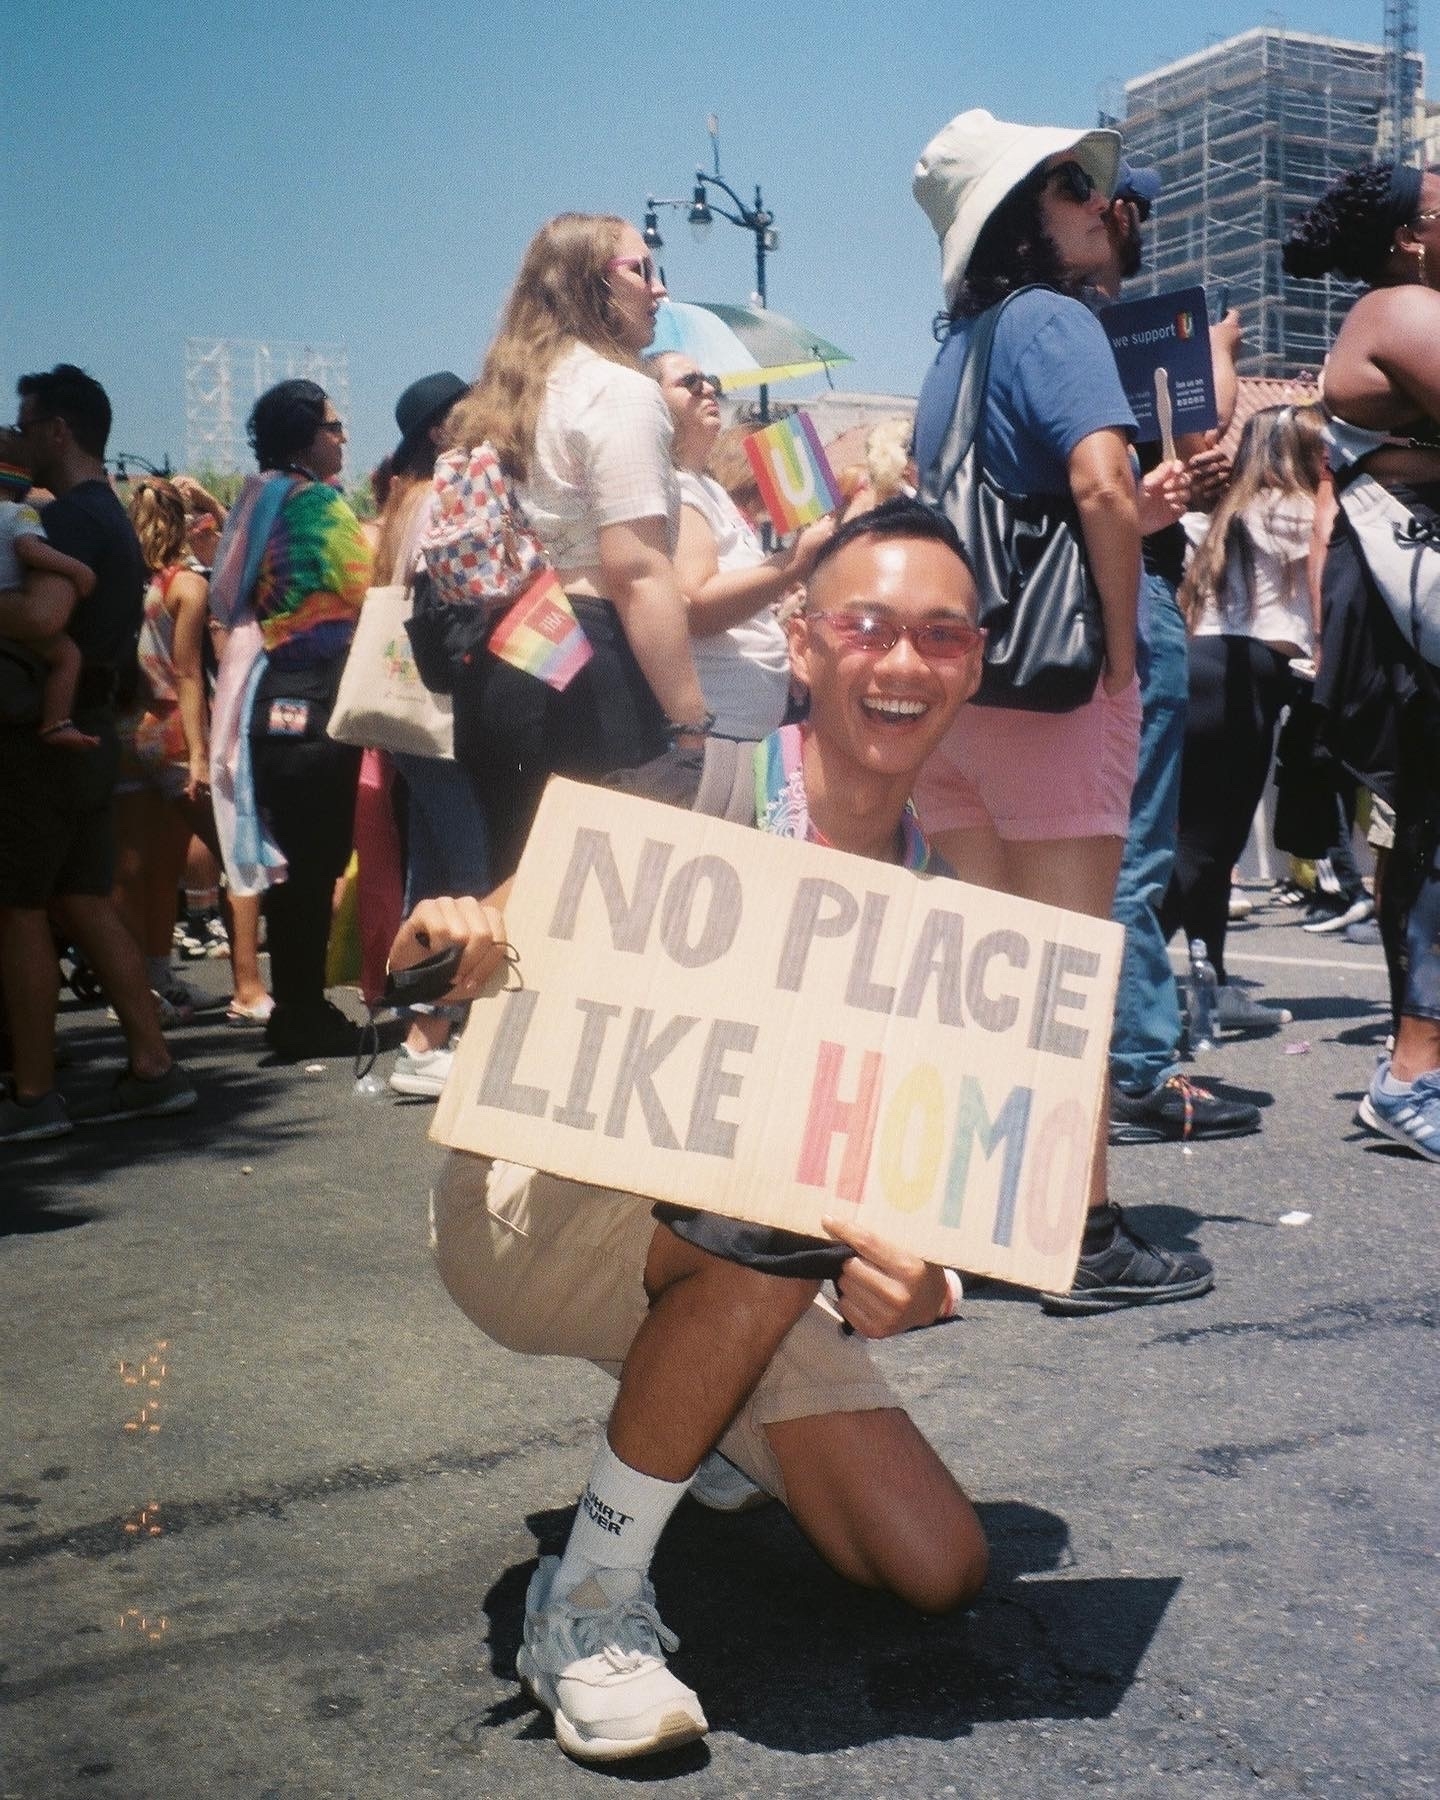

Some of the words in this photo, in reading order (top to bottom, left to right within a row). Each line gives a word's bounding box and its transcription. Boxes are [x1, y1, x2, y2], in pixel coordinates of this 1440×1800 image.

[1112, 335, 1129, 348] we
[1132, 323, 1176, 346] support
[546, 826, 744, 969] NO
[774, 876, 1101, 1060] PLACE
[476, 988, 759, 1160] LIKE
[794, 1039, 1092, 1257] HOMO
